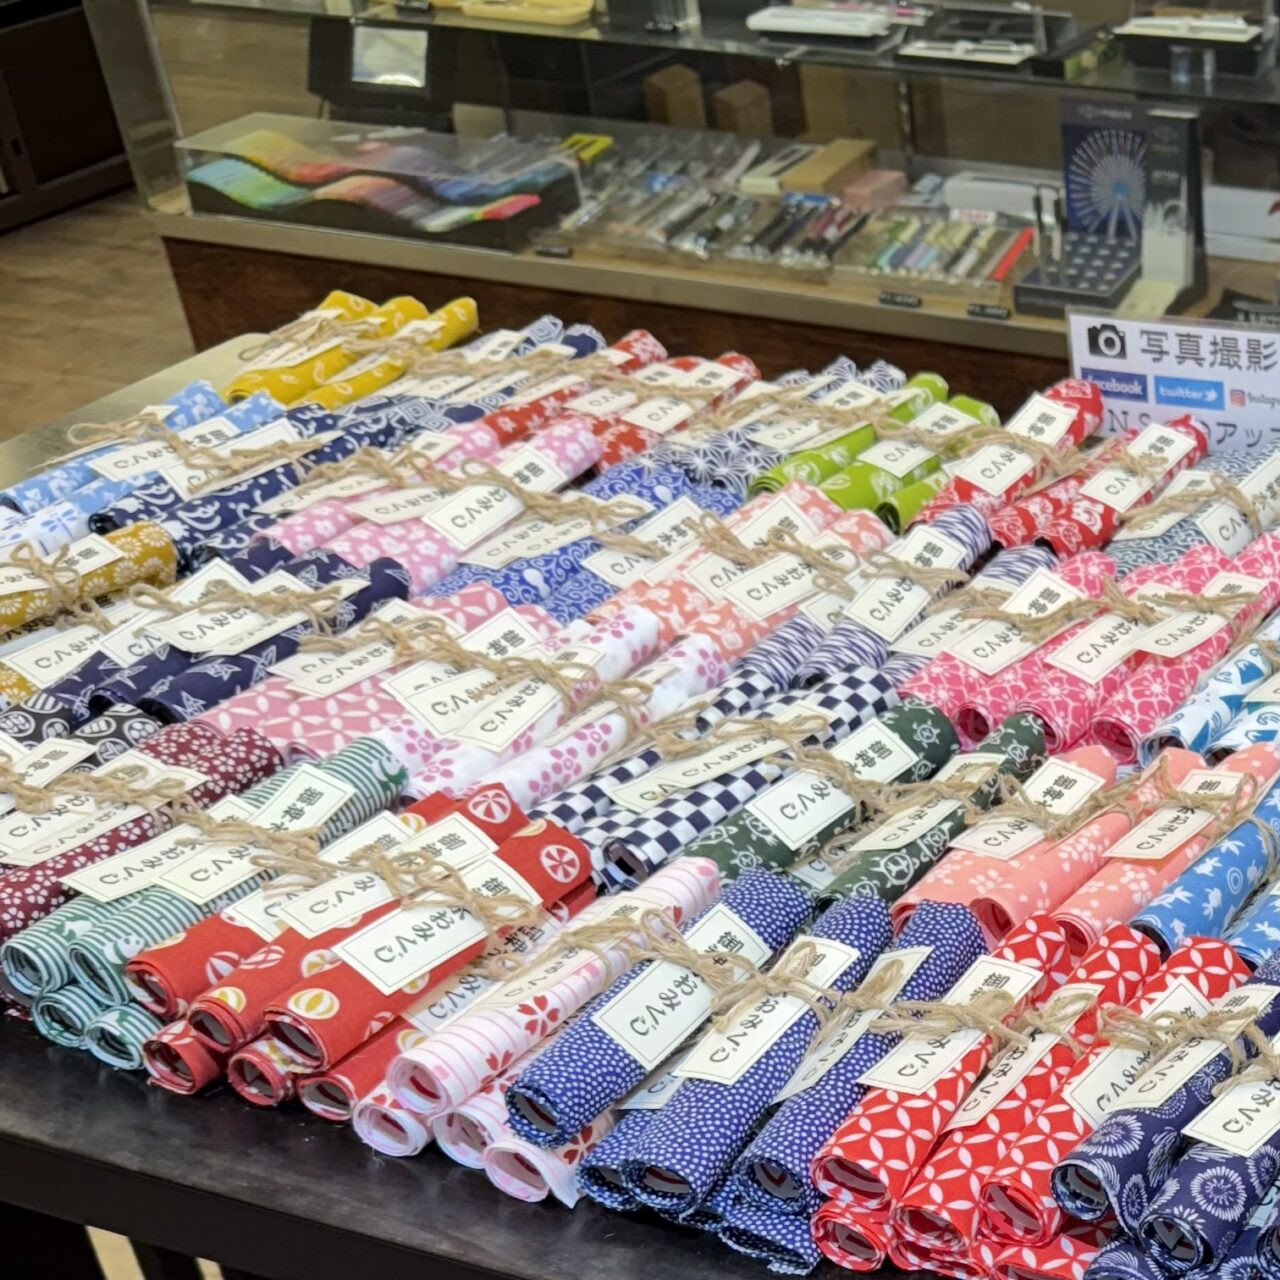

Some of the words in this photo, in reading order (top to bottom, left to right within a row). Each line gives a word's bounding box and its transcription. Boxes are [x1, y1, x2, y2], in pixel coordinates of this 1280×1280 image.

[1139, 328, 1279, 373] 写真撮影
[1159, 386, 1204, 400] twitter
